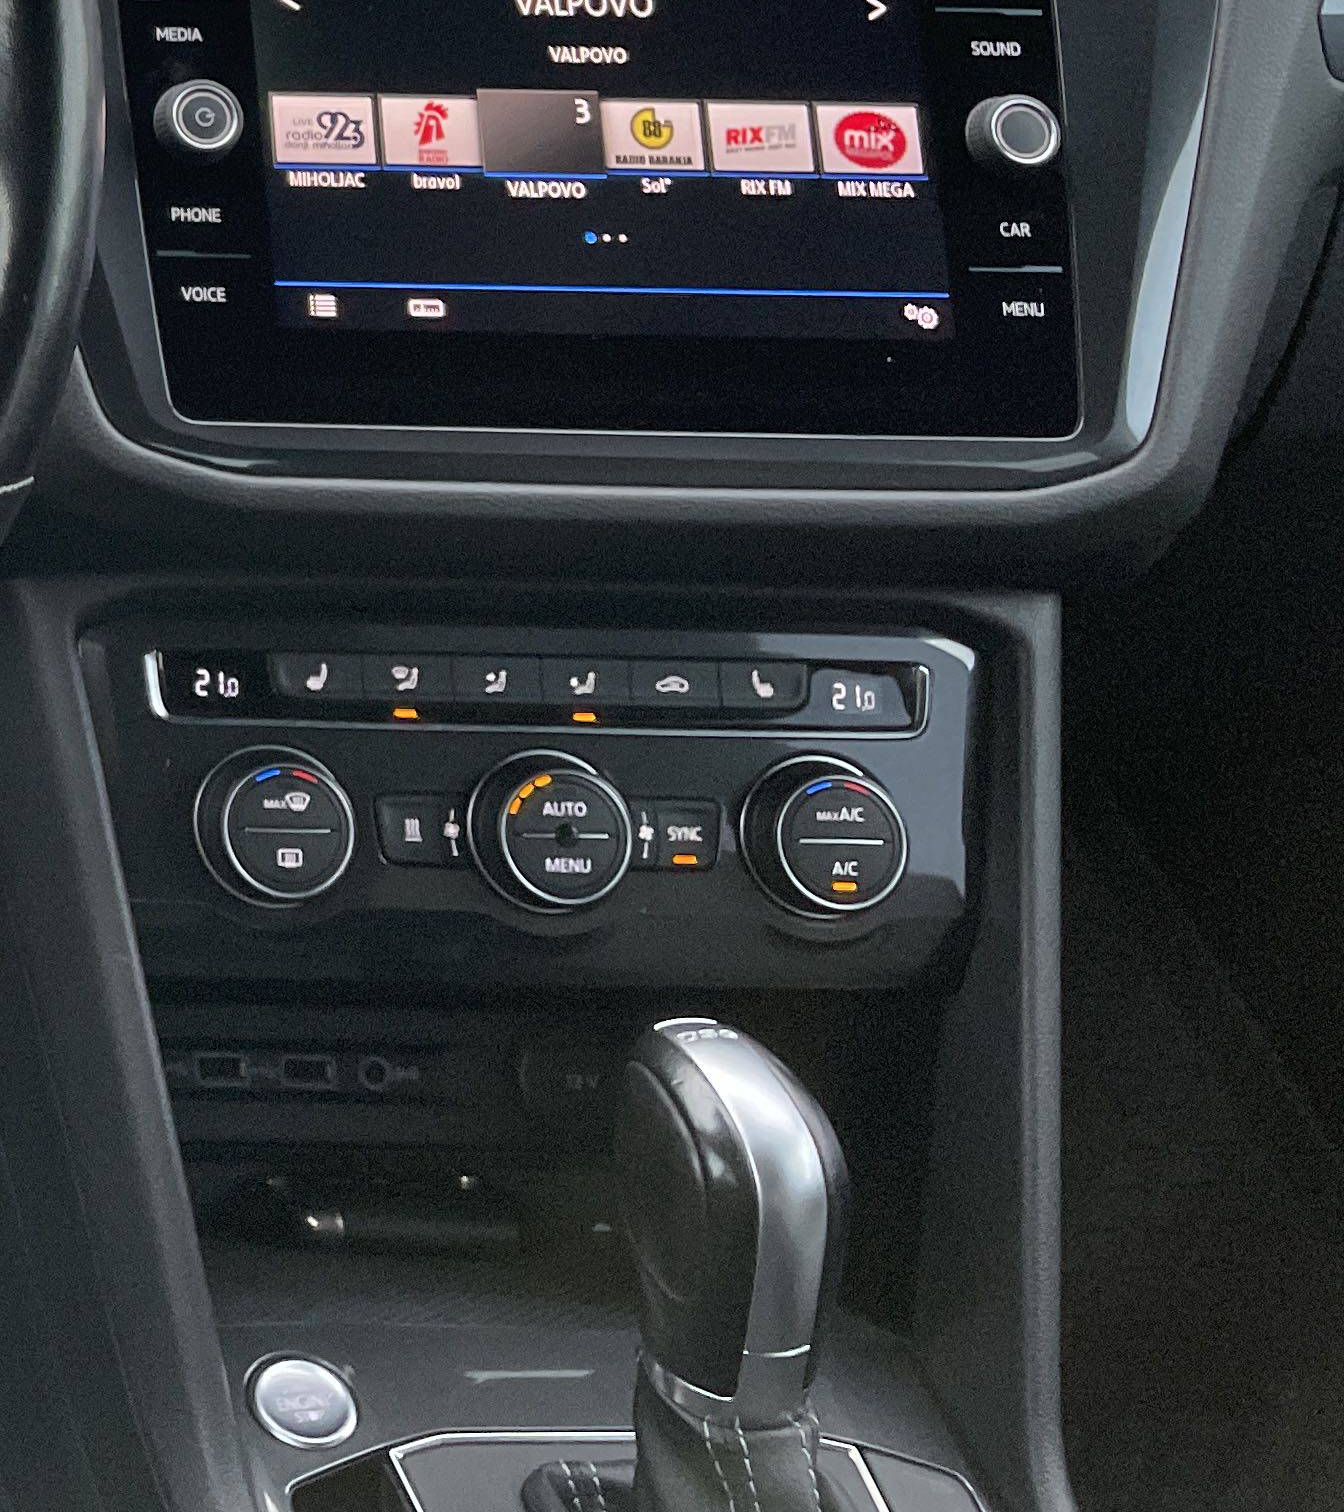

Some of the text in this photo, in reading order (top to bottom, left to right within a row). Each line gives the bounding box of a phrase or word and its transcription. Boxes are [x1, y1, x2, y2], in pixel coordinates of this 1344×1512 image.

[155, 26, 203, 43] MEDIA
[548, 45, 629, 65] VALPOVO
[970, 40, 1022, 57] SOUND
[574, 98, 592, 125] 3
[287, 170, 366, 188] MIHOLJAC
[740, 178, 793, 196] RIX FM
[506, 180, 588, 199] VALPOVO
[837, 180, 915, 198] MIX MEGA
[170, 205, 222, 224] PHONE
[999, 221, 1033, 239] CAR
[181, 285, 227, 303] VOICE
[1002, 301, 1046, 318] MENU
[263, 798, 287, 810] MAX
[542, 800, 588, 818] AUTO
[840, 806, 866, 823] A/C
[666, 825, 704, 842] SYNC
[545, 856, 593, 874] MENU
[831, 860, 860, 877] A/C
